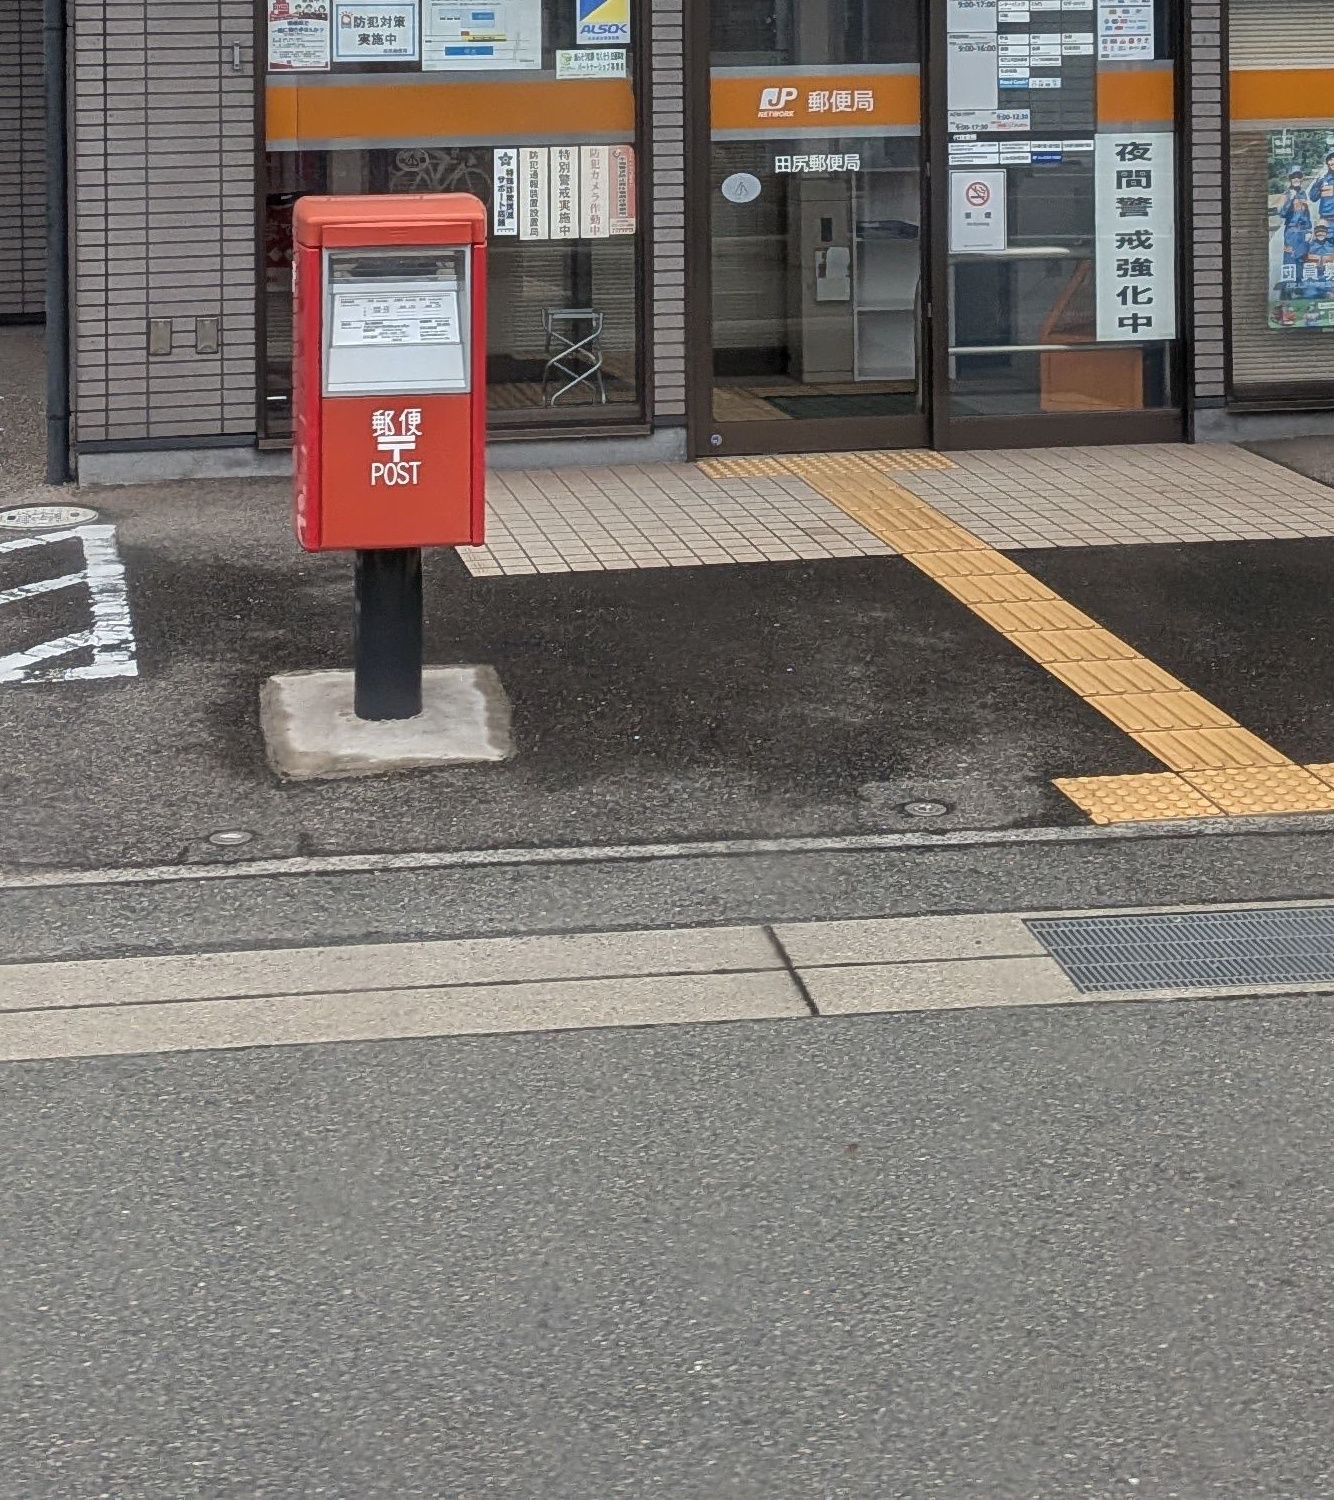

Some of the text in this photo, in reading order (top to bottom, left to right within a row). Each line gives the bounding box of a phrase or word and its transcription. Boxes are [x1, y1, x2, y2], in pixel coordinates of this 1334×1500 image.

[353, 16, 406, 29] 防犯対策
[580, 23, 628, 35] ALSOK
[357, 32, 398, 46] 実施中
[759, 87, 798, 110] JP
[807, 90, 875, 113] 郵便局
[757, 110, 795, 118] NETWORK
[774, 153, 861, 174] 田尻郵便局
[558, 148, 571, 237] 特別警戒実施中
[589, 147, 601, 236] 防犯カメラ作動中
[1114, 141, 1155, 334] 夜間警戒強化中
[371, 408, 423, 437] 郵便
[370, 461, 422, 486] POST
